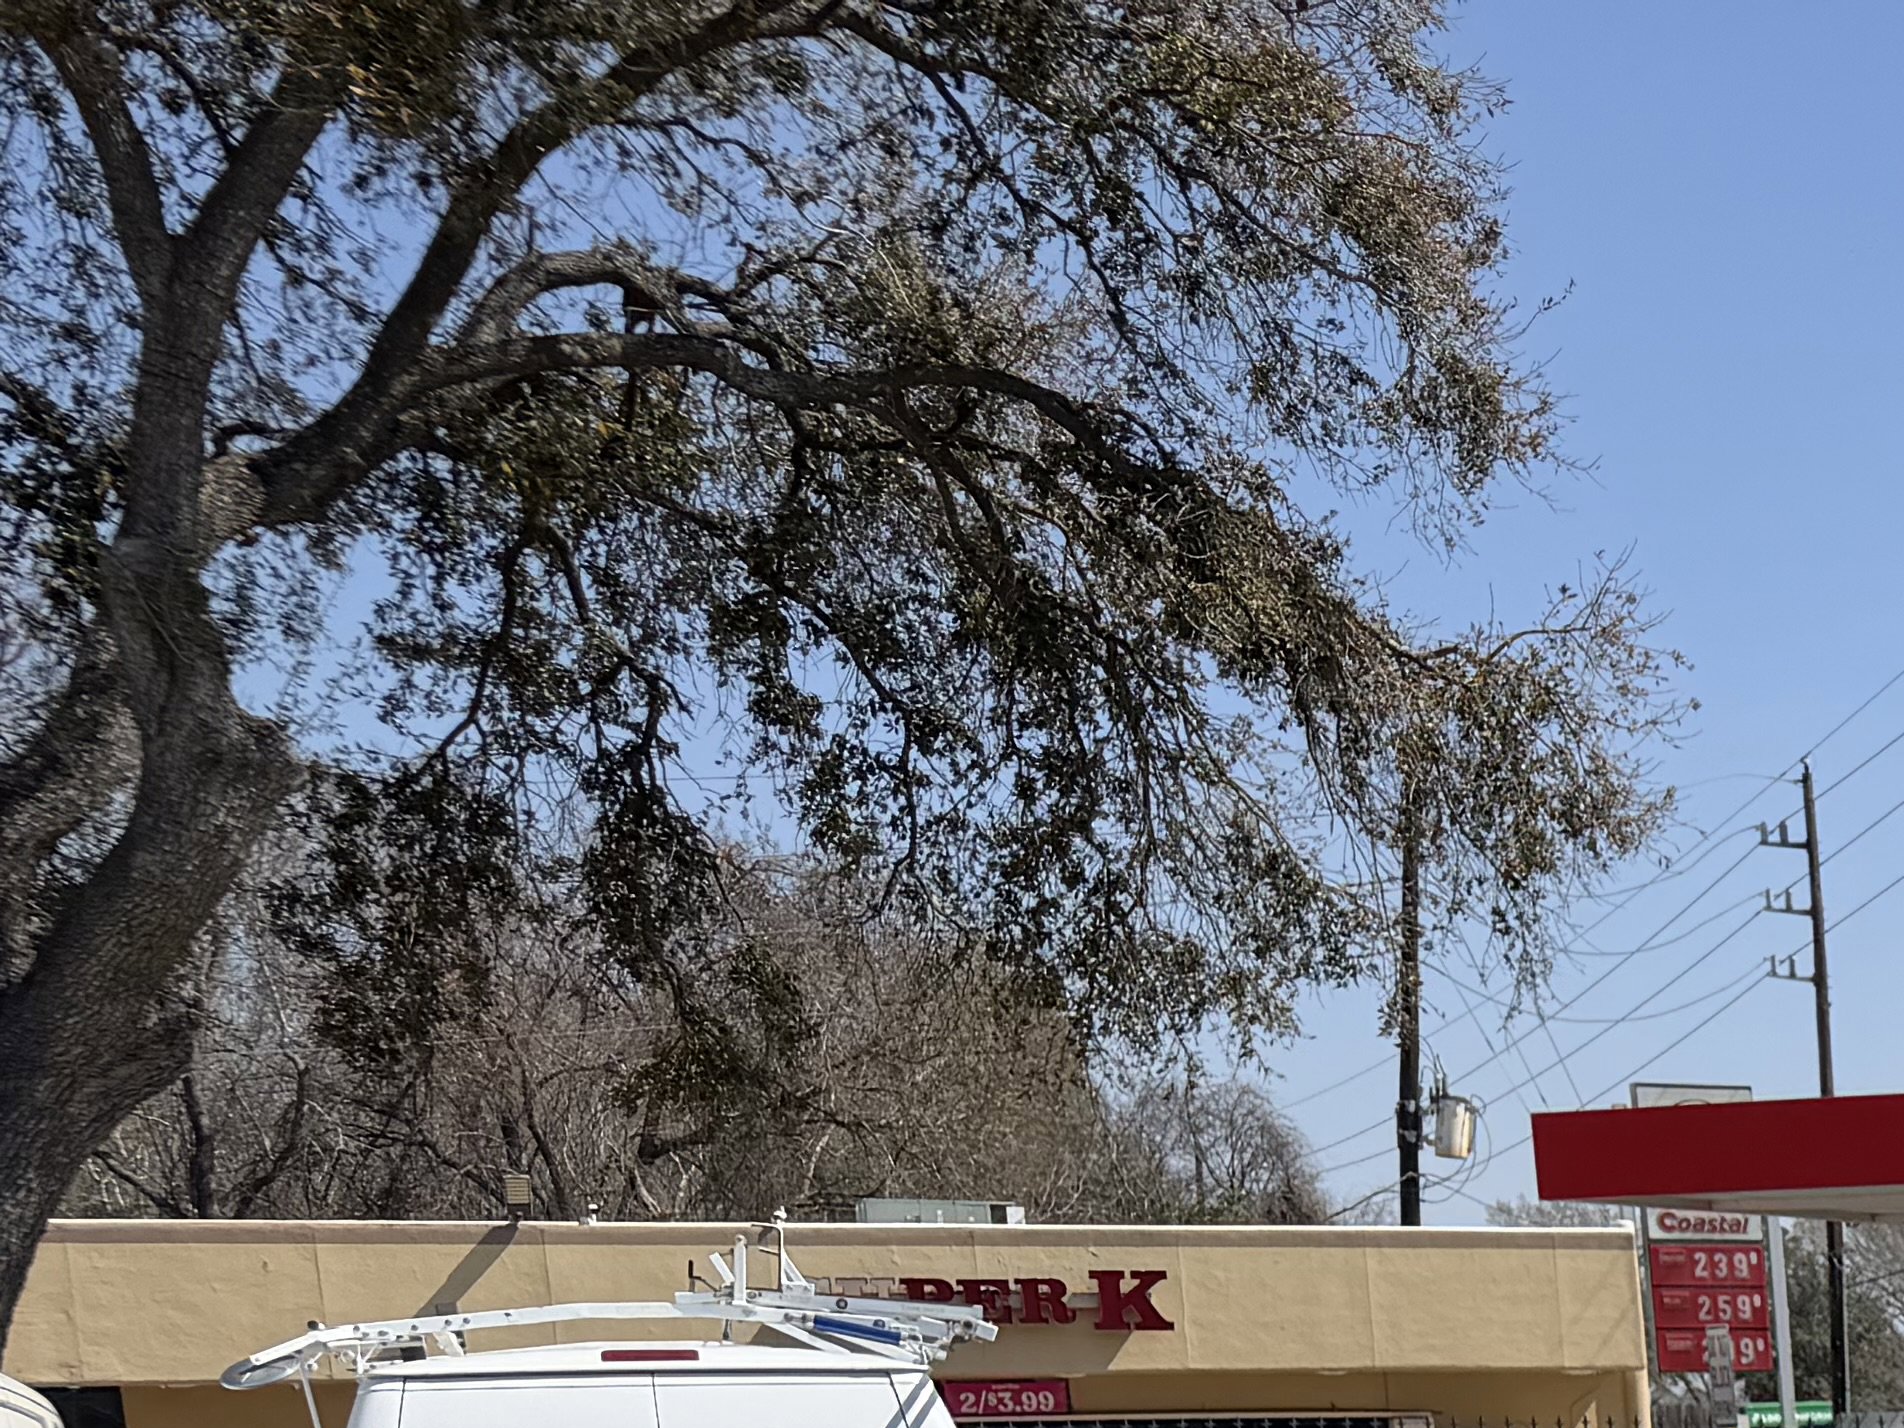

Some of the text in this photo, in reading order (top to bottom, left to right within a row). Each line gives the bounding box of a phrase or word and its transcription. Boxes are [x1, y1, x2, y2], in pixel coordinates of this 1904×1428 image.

[1656, 1211, 1749, 1235] Coastal
[1088, 1270, 1175, 1331] K
[959, 1390, 1055, 1414] 2/$3.99
